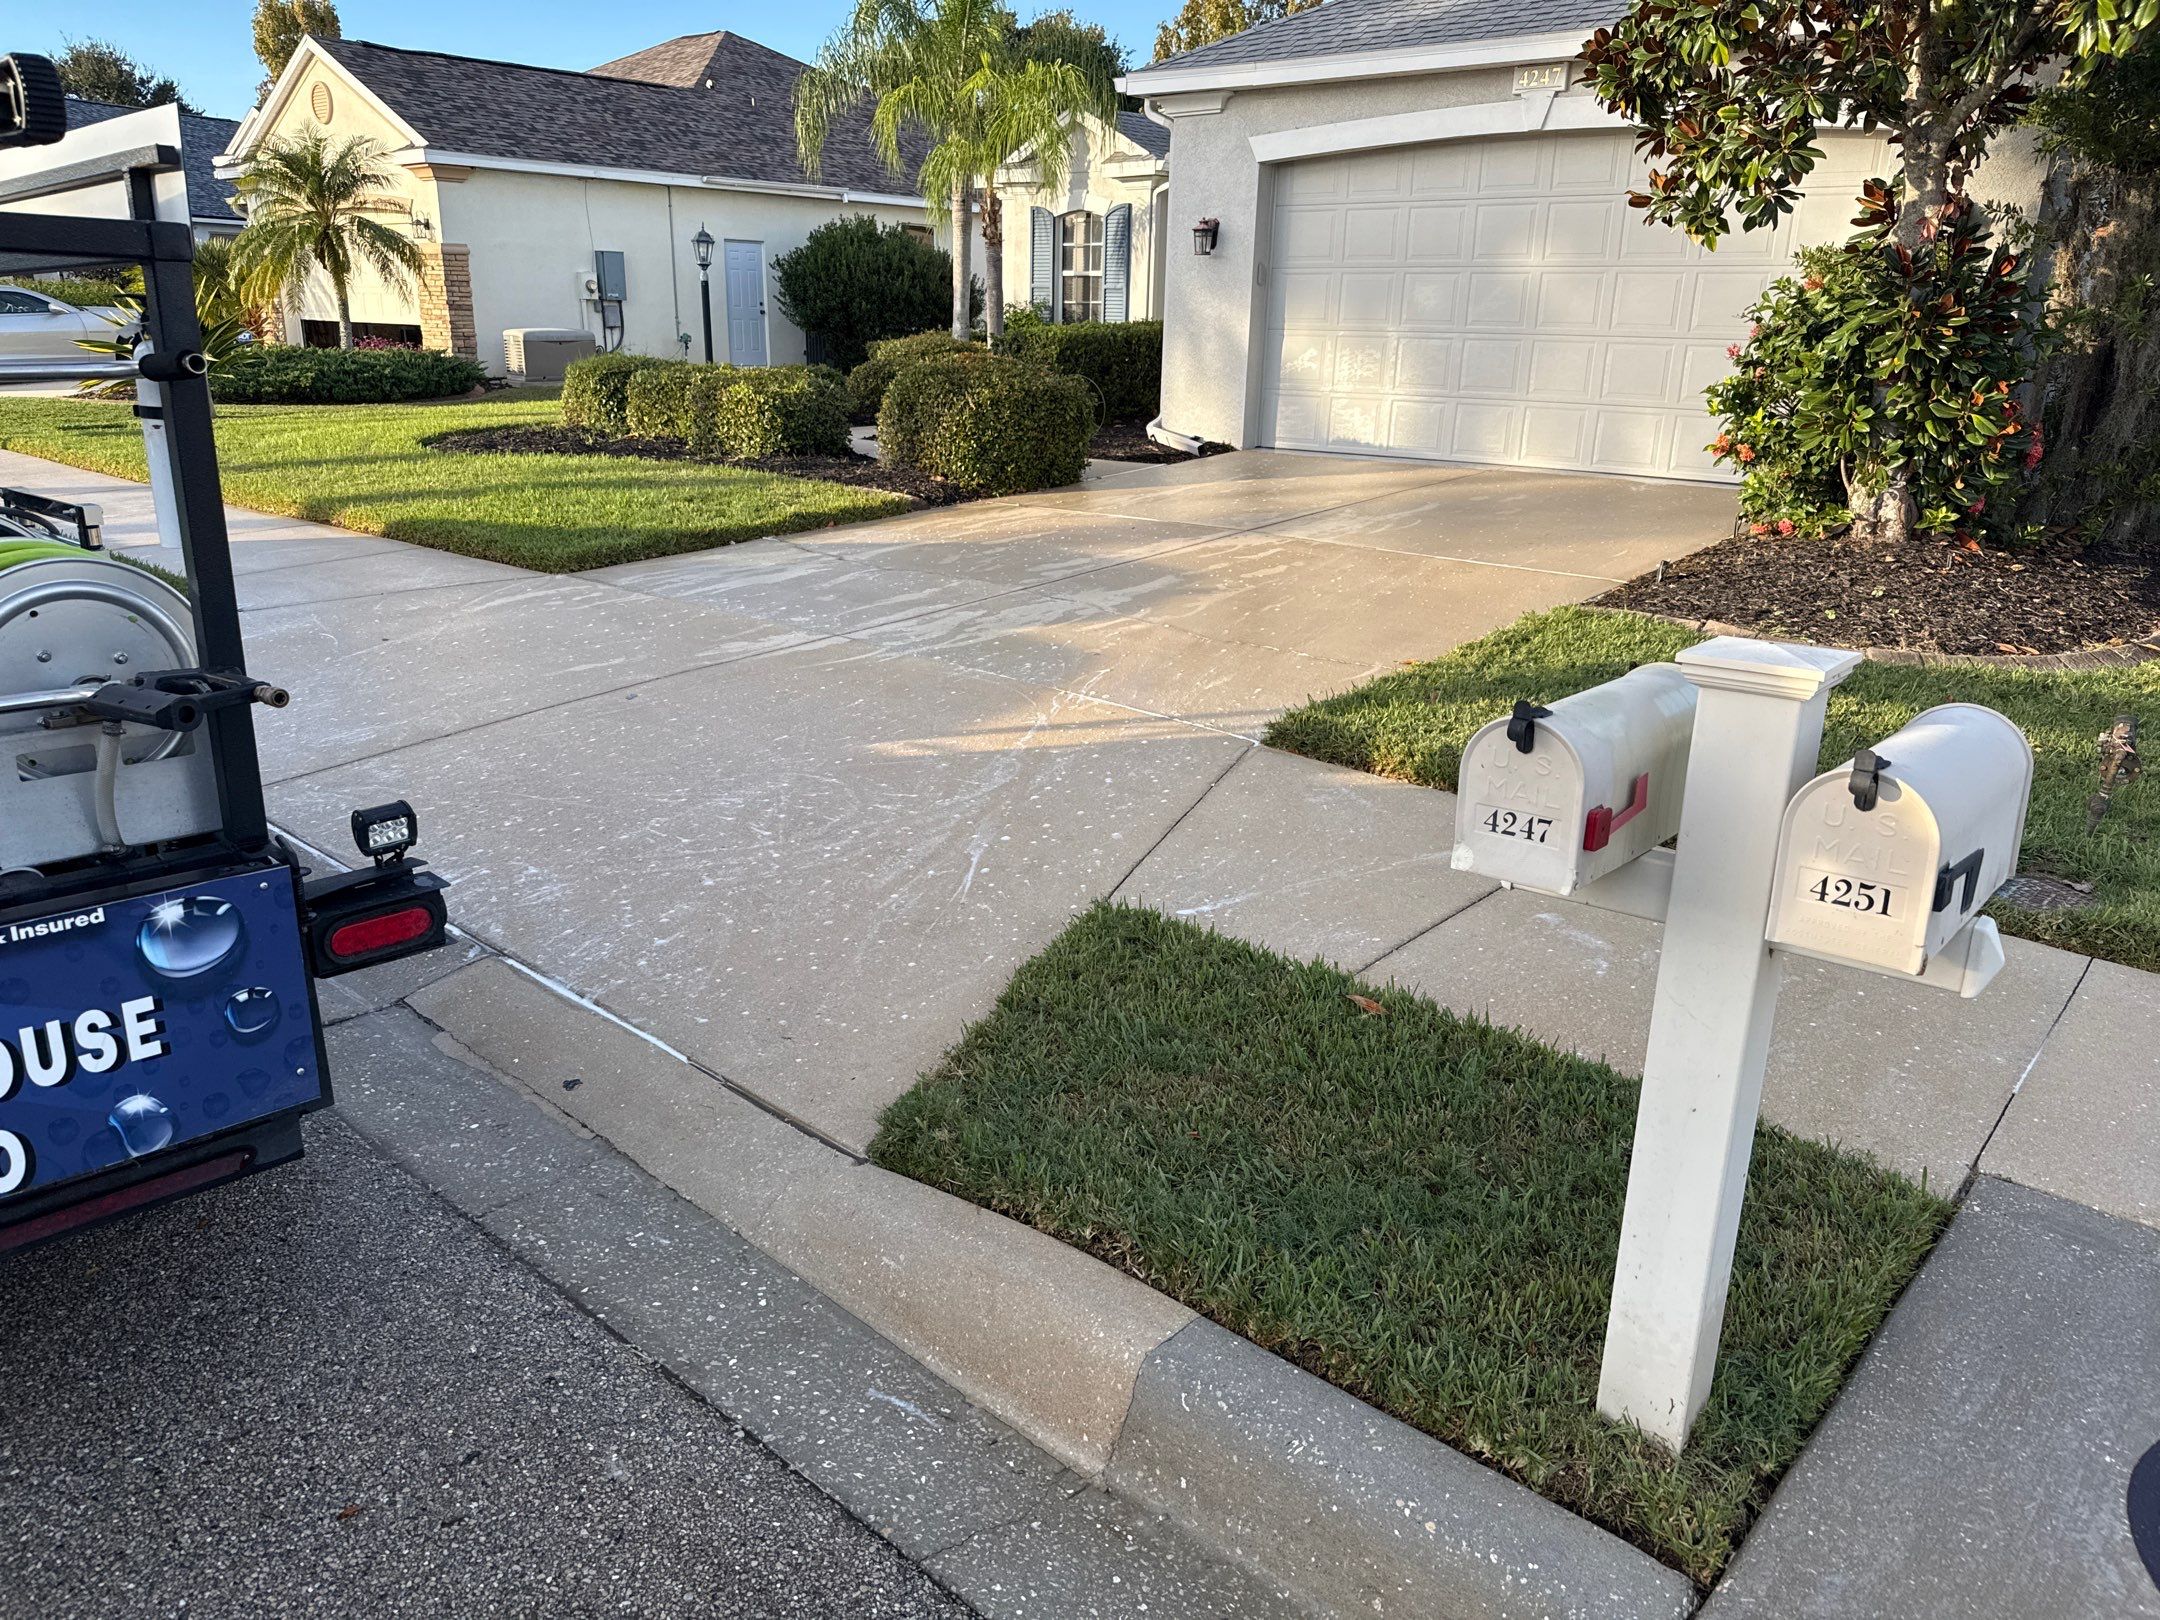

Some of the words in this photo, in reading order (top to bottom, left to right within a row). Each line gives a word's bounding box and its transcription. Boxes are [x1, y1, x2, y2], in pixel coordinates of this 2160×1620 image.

[1518, 67, 1562, 87] 4247
[1483, 809, 1554, 843] 4247
[1811, 834, 1909, 876] MAIL
[1809, 875, 1893, 918] 4251
[10, 907, 106, 942] Insured
